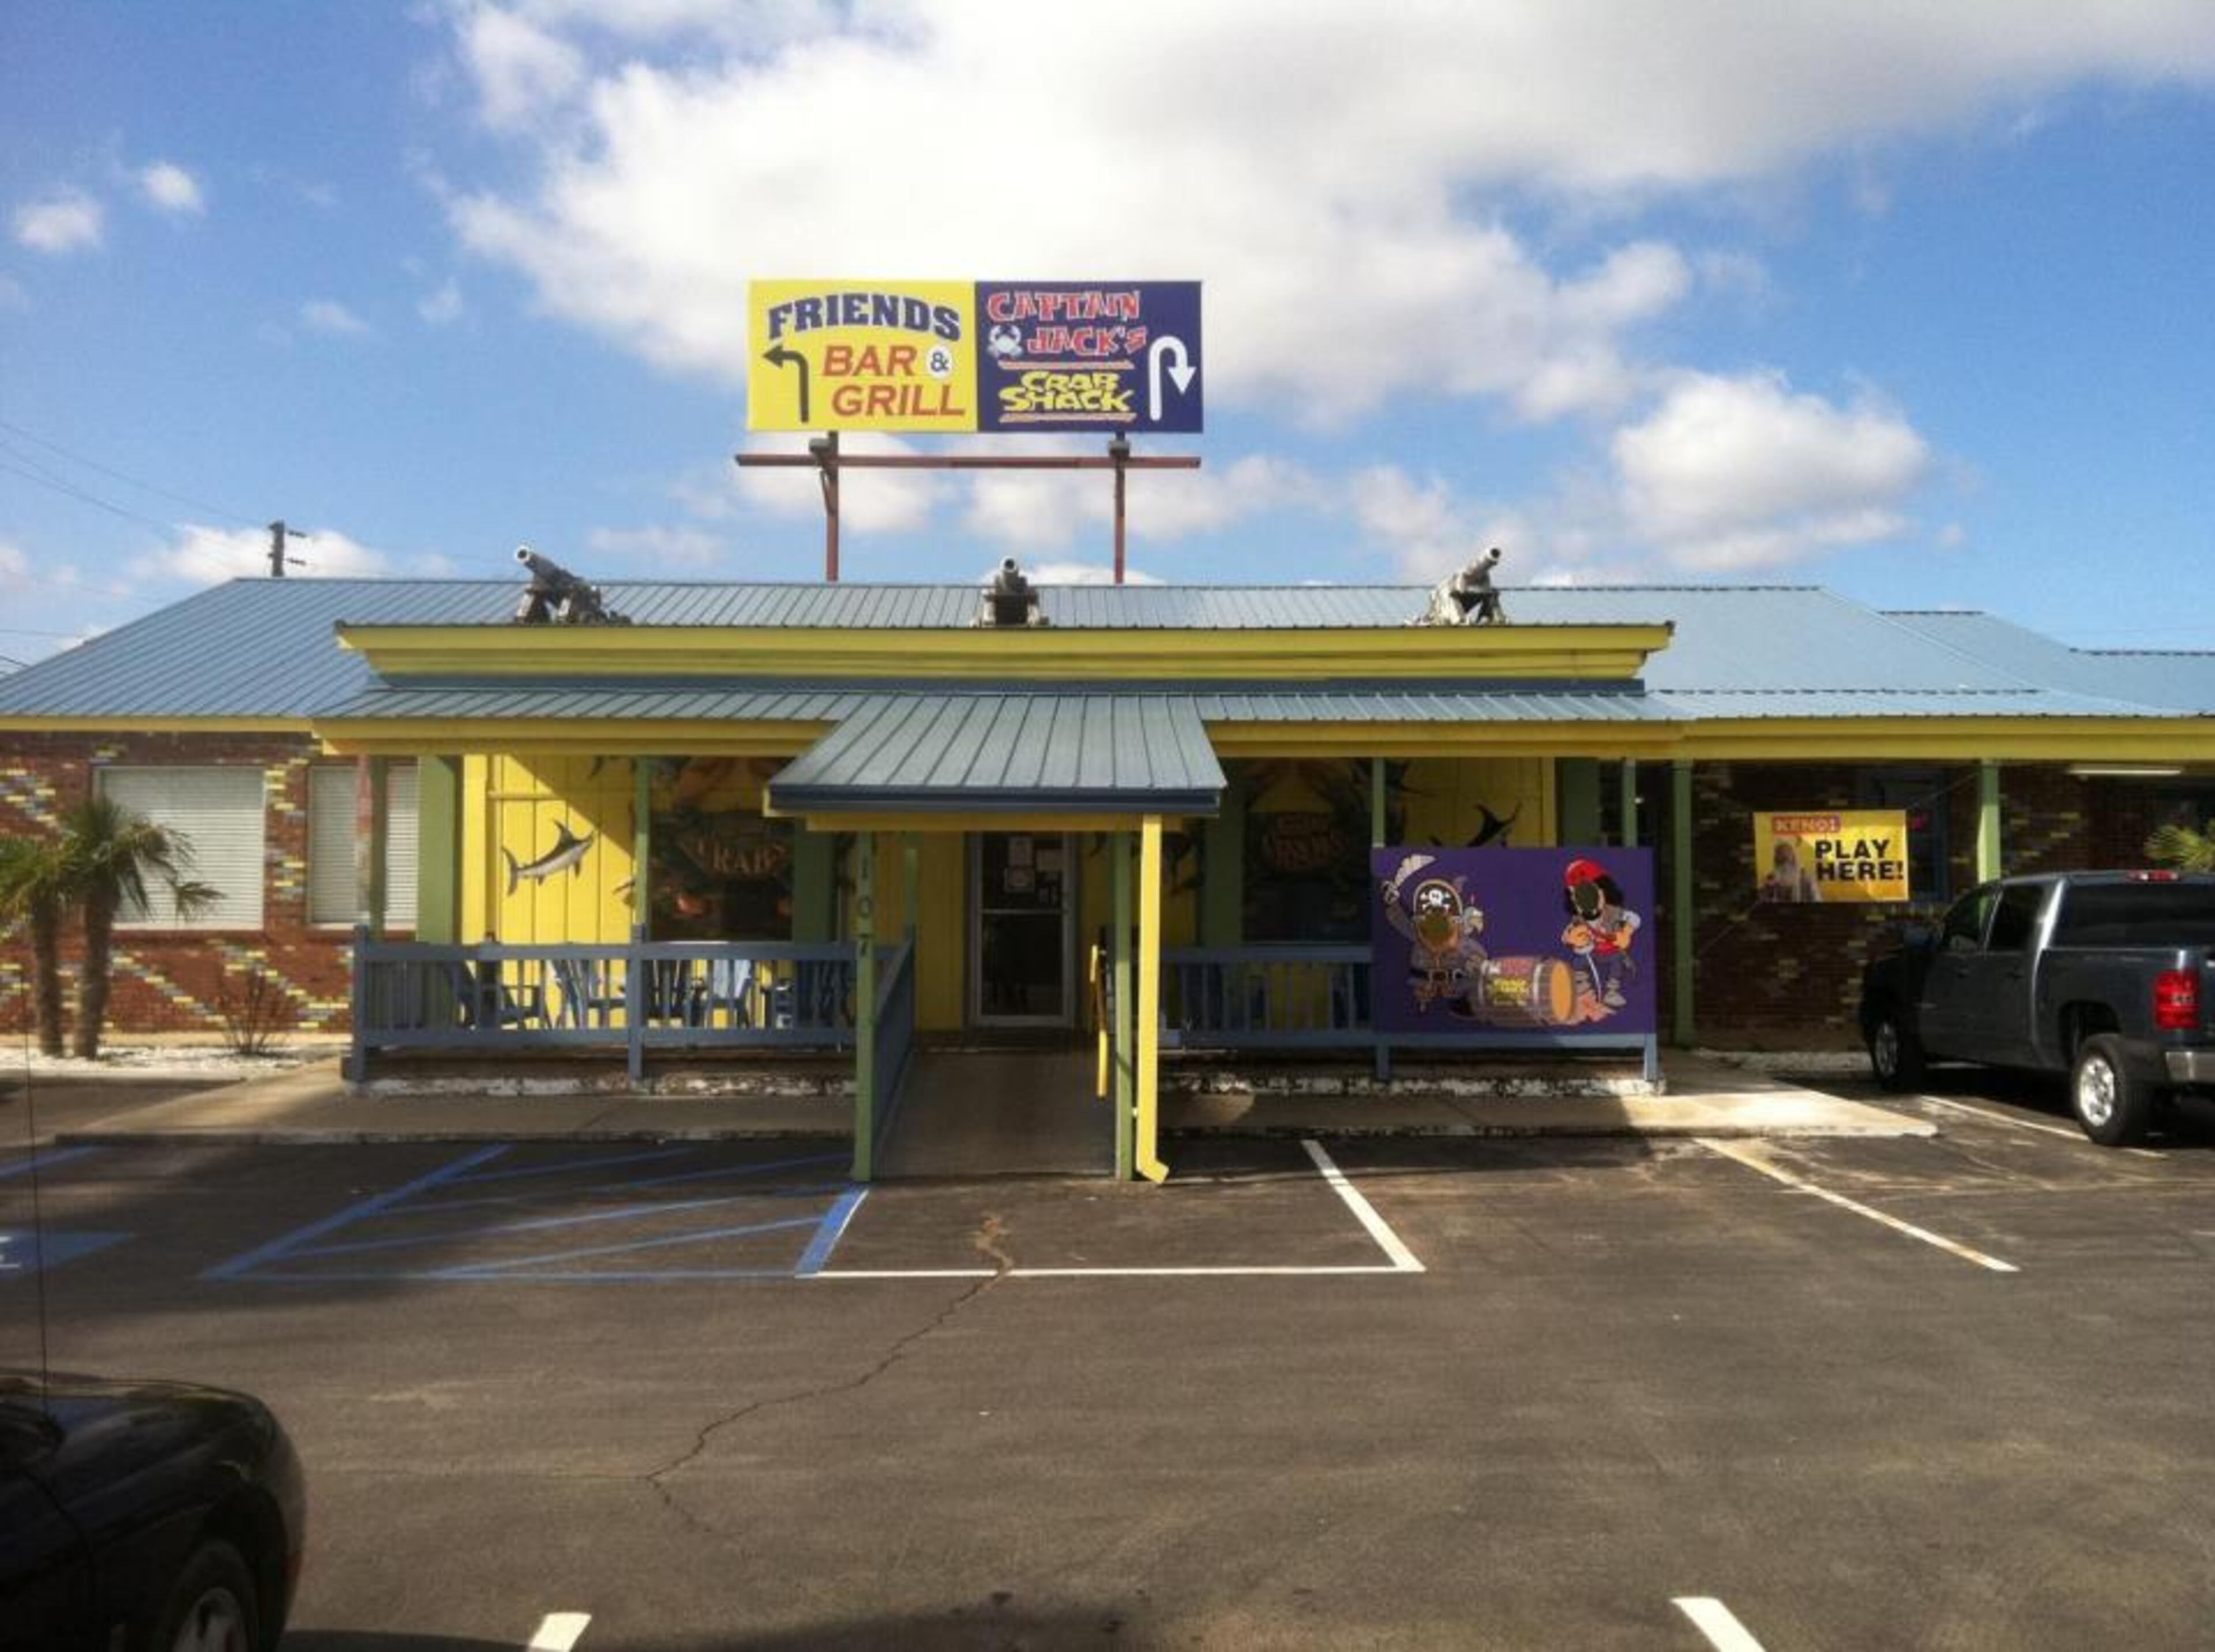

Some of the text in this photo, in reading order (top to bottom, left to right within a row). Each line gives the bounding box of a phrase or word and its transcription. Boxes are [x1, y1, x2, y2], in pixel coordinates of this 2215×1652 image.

[768, 292, 961, 341] FRIENDS
[988, 290, 1140, 322] CAPTAIN
[1027, 325, 1147, 356] JACK'S
[823, 345, 949, 376] BAR &
[1020, 371, 1120, 392] CRAB
[832, 384, 966, 416] GRILL
[998, 387, 1135, 412] SHACK
[1815, 839, 1890, 859] PLAY
[1816, 861, 1904, 881] HERE!
